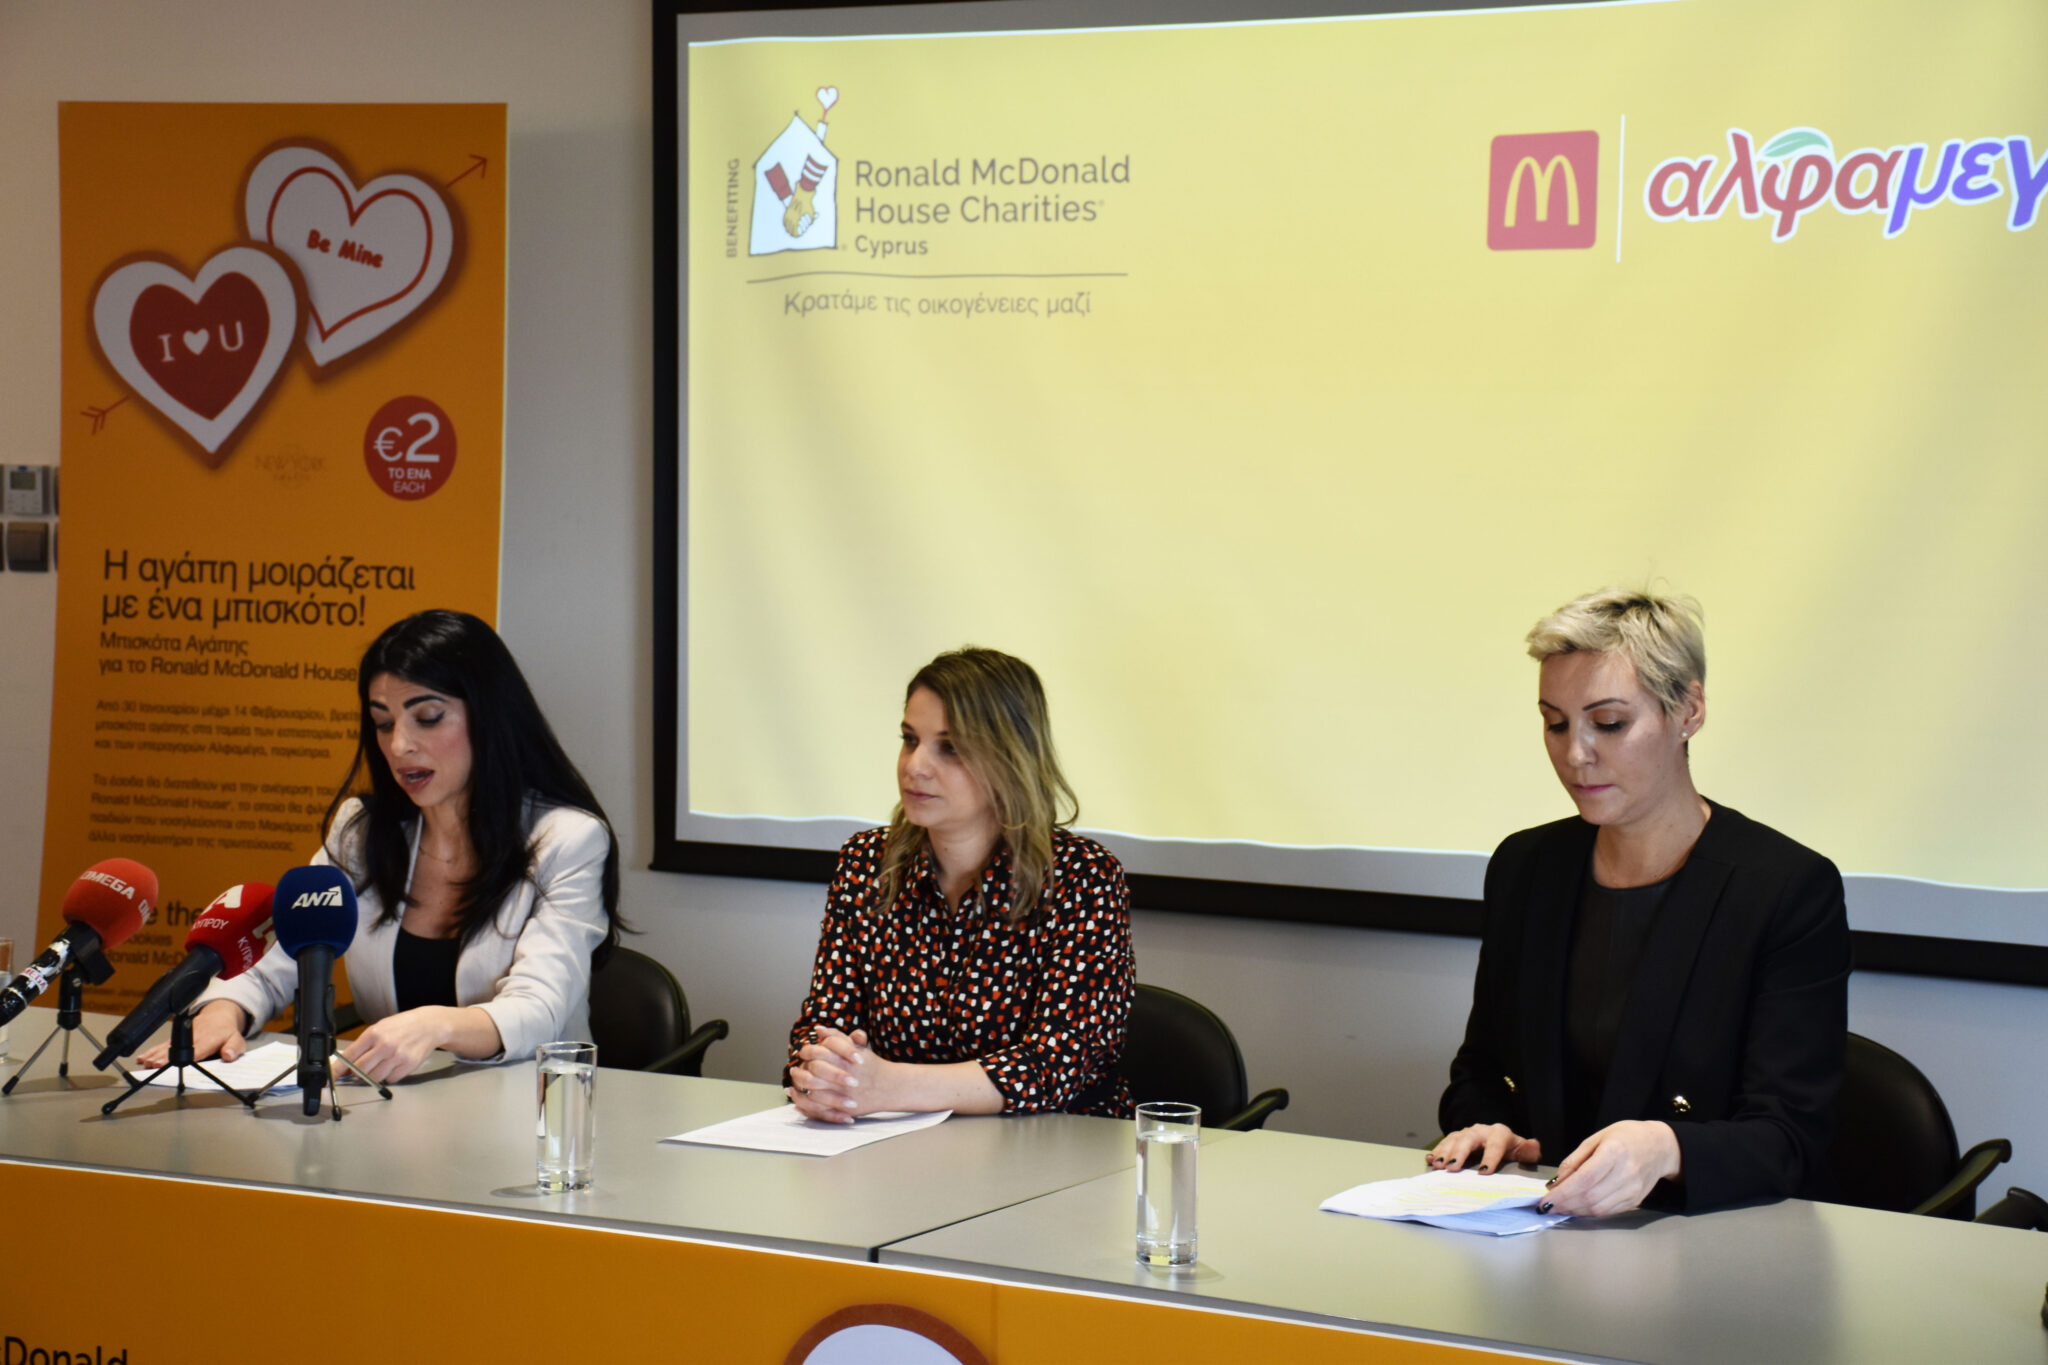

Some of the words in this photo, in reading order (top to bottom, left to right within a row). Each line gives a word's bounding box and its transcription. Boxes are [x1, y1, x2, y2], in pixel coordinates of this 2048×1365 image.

[856, 158, 960, 188] Ronald
[972, 155, 1130, 186] McDonald
[727, 158, 740, 258] BENEFITING
[855, 196, 950, 224] House
[307, 229, 331, 253] Be
[337, 239, 383, 268] Mine
[855, 235, 928, 258] Cyprus
[784, 289, 878, 318] Κρατάμε
[885, 296, 911, 316] τις
[918, 291, 1039, 319] οικογένειες
[1047, 291, 1092, 318] μαζί
[157, 333, 176, 363] I
[219, 320, 244, 352] U
[393, 480, 426, 493] EACH
[138, 550, 237, 592] αγάπη
[248, 555, 415, 594] μοιράζεται
[102, 594, 138, 625] με
[148, 587, 202, 622] ένα
[213, 592, 366, 629] μπισκότο!
[100, 631, 181, 651] Μπισκότα
[186, 634, 248, 656] Αγάπης
[99, 658, 122, 676] για
[127, 659, 146, 673] το
[151, 656, 209, 675] Ronald
[214, 659, 299, 680] McDonald
[303, 663, 358, 682] House
